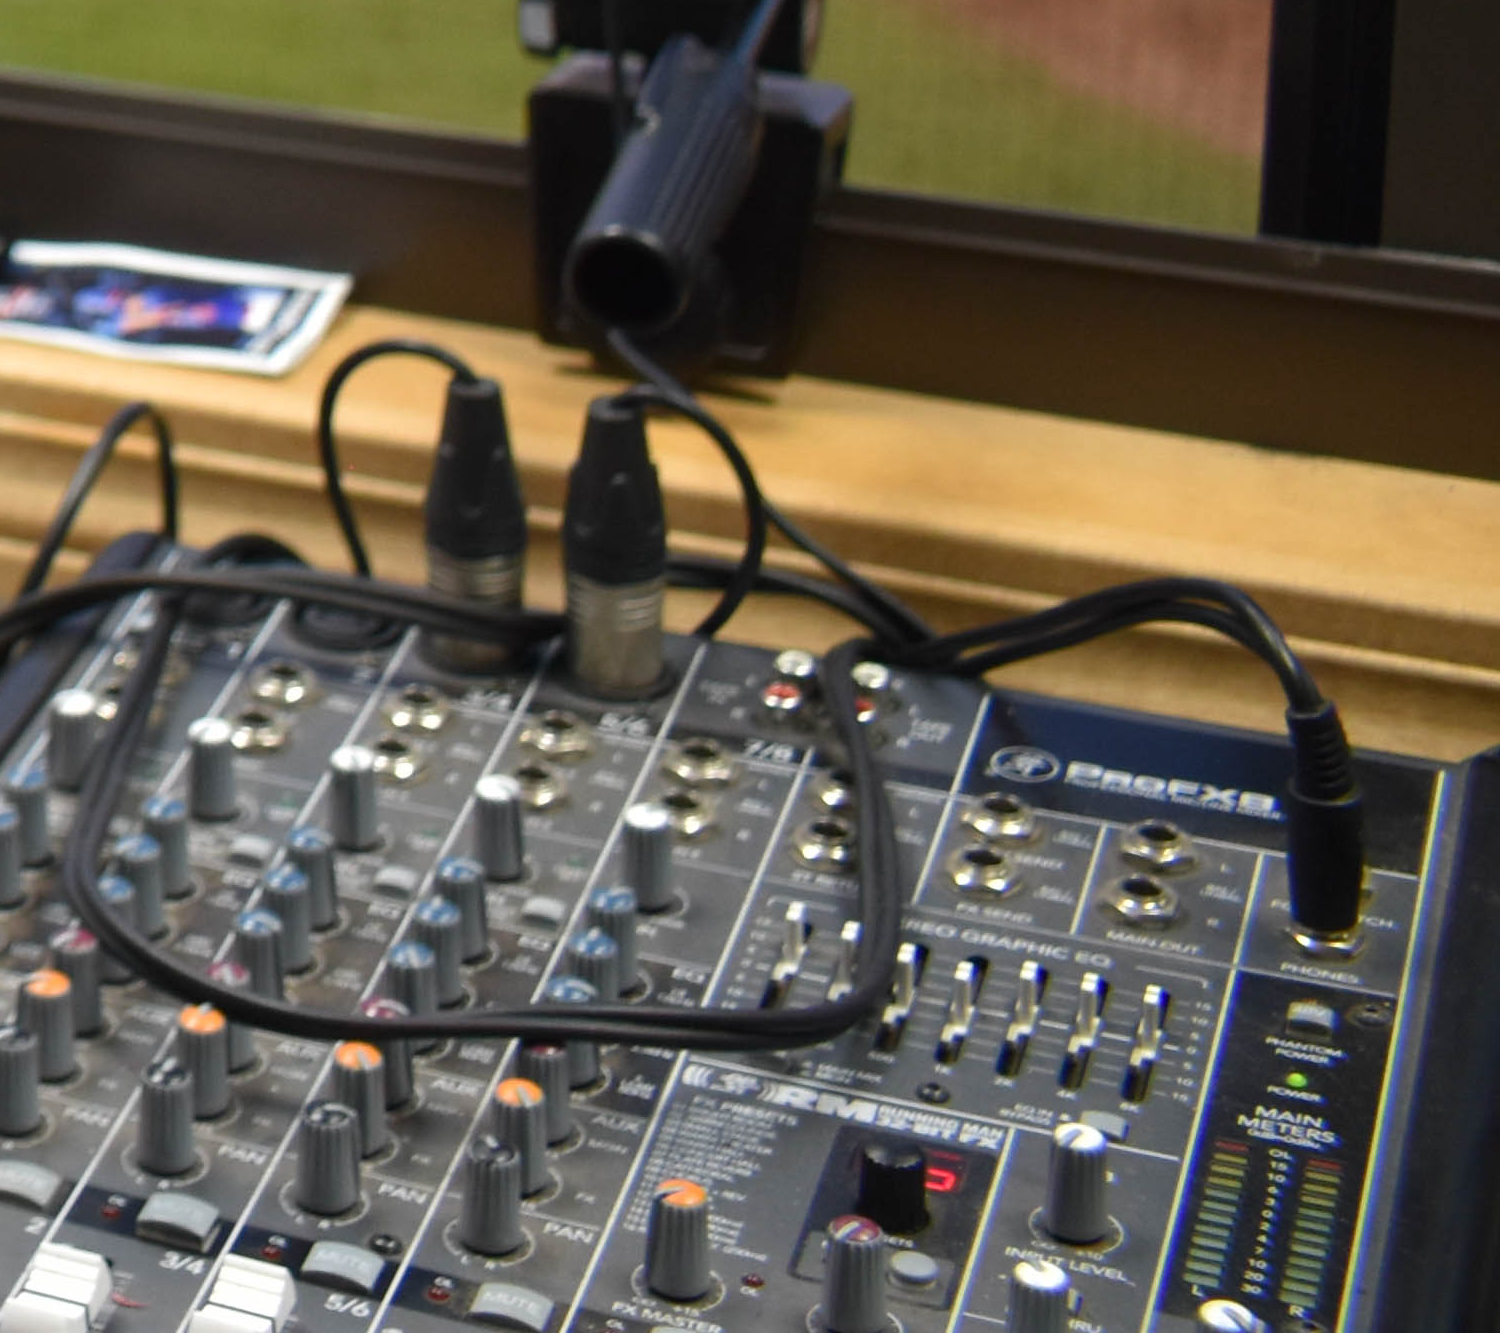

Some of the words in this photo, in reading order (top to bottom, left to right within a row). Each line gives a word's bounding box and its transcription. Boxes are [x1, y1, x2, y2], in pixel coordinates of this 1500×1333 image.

[745, 739, 795, 762] 7/8
[1065, 760, 1281, 813] PROFX8
[960, 931, 1069, 961] GRAPHIC
[1074, 948, 1113, 969] EQ
[1236, 1114, 1338, 1144] METERS
[1254, 1104, 1324, 1129] MAIN
[378, 1182, 428, 1204] PAN
[543, 1222, 595, 1244] PAN
[159, 1250, 206, 1275] 3/4
[1069, 1258, 1128, 1283] LEVEL
[324, 1294, 371, 1318] 5/6
[611, 1300, 640, 1319] FX
[641, 1307, 723, 1333] MASTER
